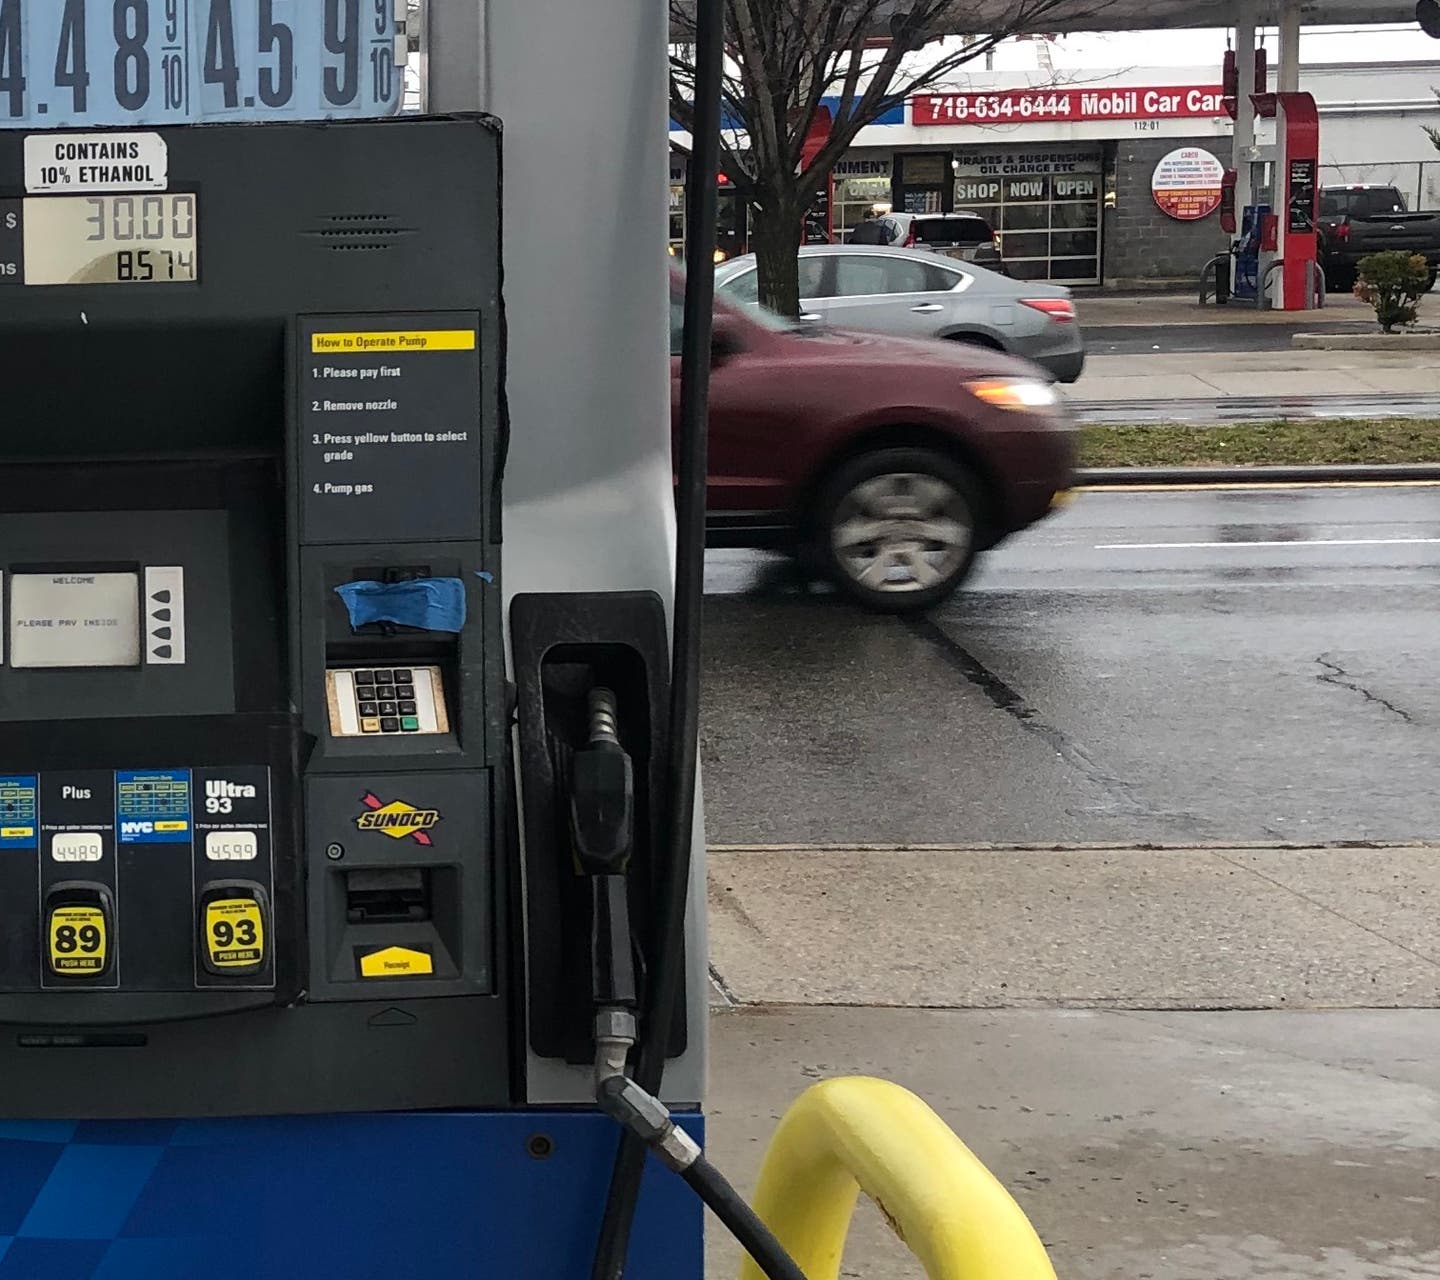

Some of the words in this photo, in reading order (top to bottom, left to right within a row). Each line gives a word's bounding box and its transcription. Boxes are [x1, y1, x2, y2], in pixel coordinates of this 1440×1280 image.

[929, 94, 1071, 119] 718-634-6444
[1081, 92, 1137, 116] Mobil
[1144, 92, 1180, 113] Car
[1186, 89, 1232, 112] Car
[55, 142, 139, 160] CONTAINS
[40, 166, 70, 184] 10%
[79, 164, 154, 183] ETHANOL
[980, 166, 999, 174] OIL
[1003, 164, 1050, 173] CHANGE
[1054, 162, 1076, 172] ETC
[957, 183, 999, 199] SHOP
[1010, 182, 1044, 197] NOW
[1056, 181, 1094, 195] OPEN
[5, 212, 17, 230] $
[86, 195, 193, 241] 30.00
[316, 337, 340, 348] How
[343, 337, 353, 347] to
[356, 336, 396, 349] Operate
[398, 335, 427, 348] Pump
[312, 368, 322, 378] 1.
[323, 366, 358, 378] Please
[360, 368, 378, 380] pay
[380, 366, 401, 377] first
[312, 401, 322, 411] 2.
[323, 400, 364, 411] Remove
[365, 399, 398, 410] nozzle
[312, 434, 322, 444] 3.
[324, 433, 353, 444] Press
[354, 432, 388, 445] yellow
[390, 432, 422, 442] button
[424, 432, 435, 441] to
[436, 431, 468, 441] select
[323, 450, 353, 463] grade
[313, 483, 323, 493] 4.
[324, 483, 353, 495] Pump
[355, 484, 373, 495] gas
[52, 576, 95, 584] WELCOME
[16, 619, 53, 627] PLEASE
[62, 785, 92, 800] Plus
[205, 780, 257, 798] Ultra
[205, 798, 233, 813] 93
[360, 812, 436, 827] SUNOCO
[121, 822, 153, 833] NYC
[55, 925, 101, 954] 89
[213, 919, 257, 947] 93
